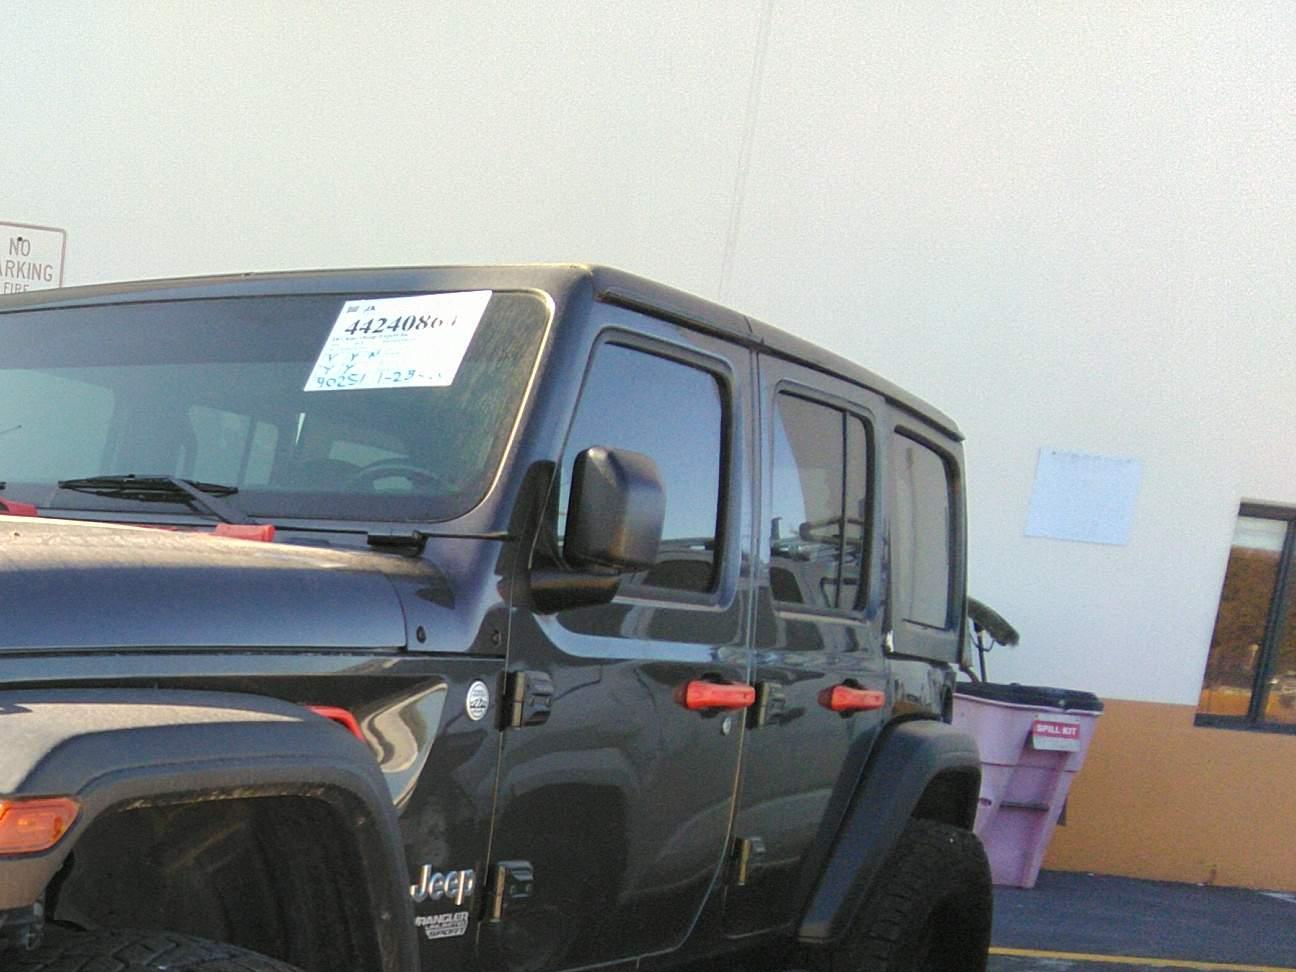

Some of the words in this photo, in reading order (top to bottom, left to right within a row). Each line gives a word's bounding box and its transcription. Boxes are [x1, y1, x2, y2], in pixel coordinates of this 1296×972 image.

[9, 238, 31, 256] NO
[1037, 724, 1060, 734] SPILL
[1062, 726, 1078, 735] KIT
[409, 864, 475, 906] Jeep
